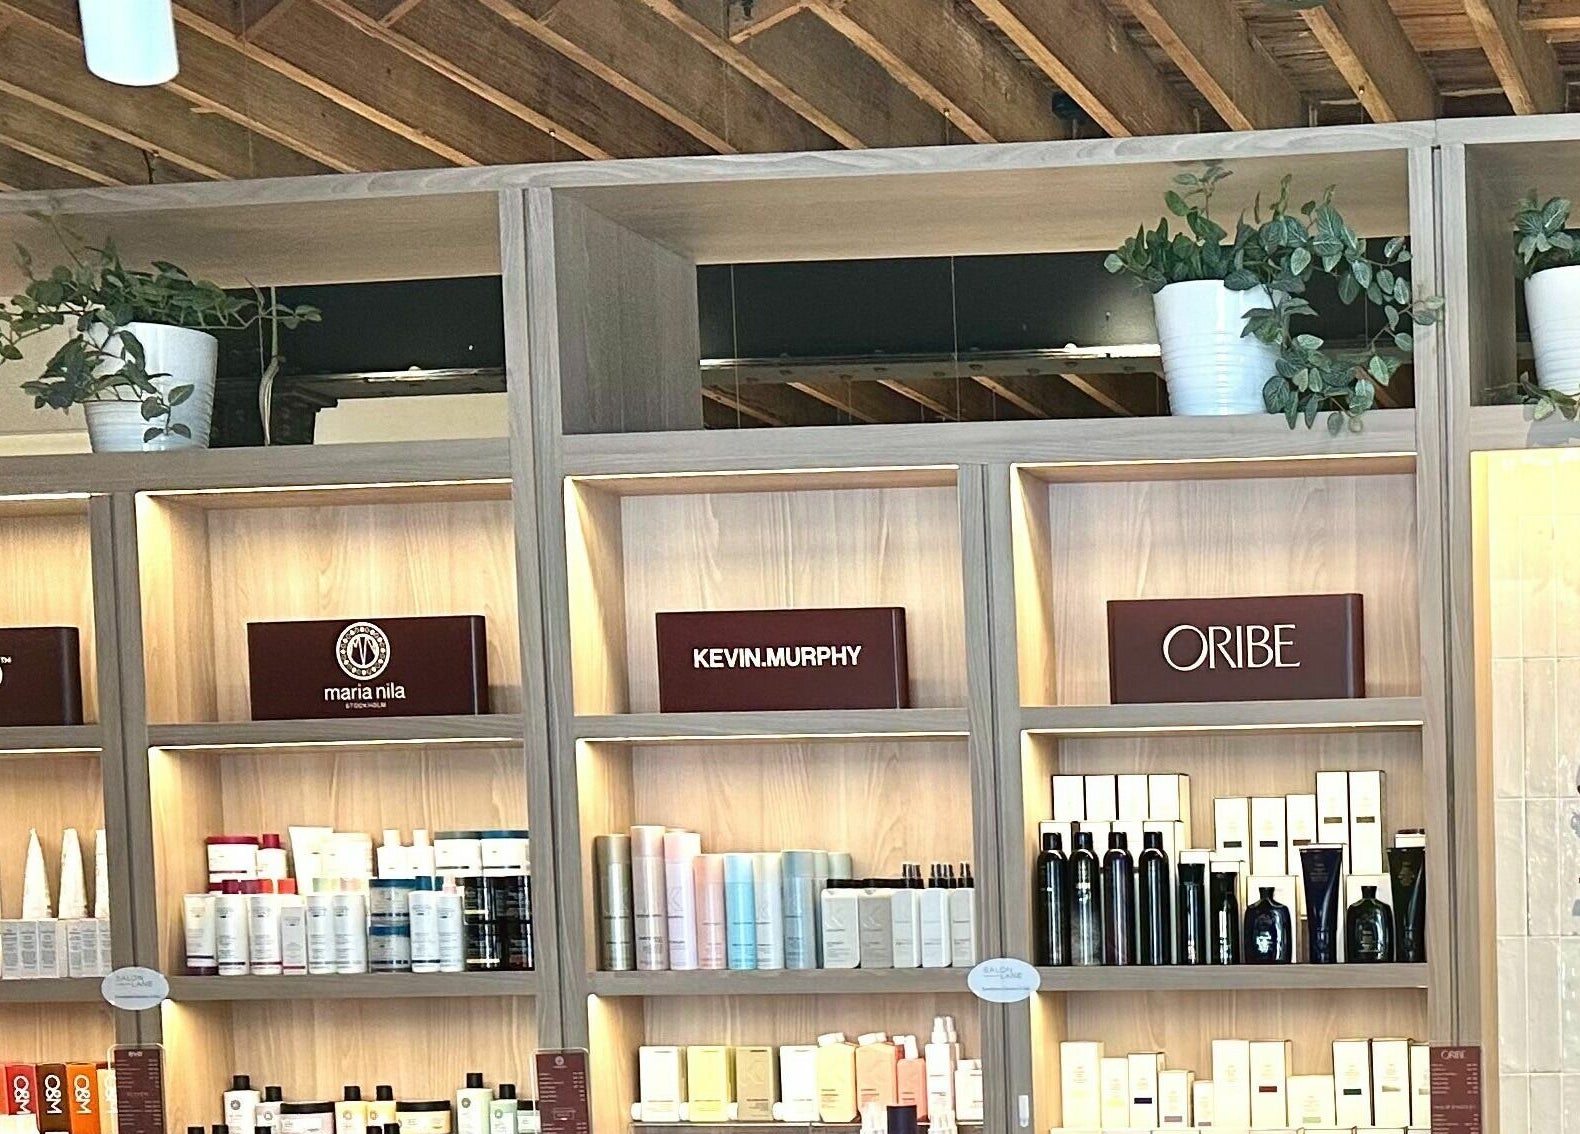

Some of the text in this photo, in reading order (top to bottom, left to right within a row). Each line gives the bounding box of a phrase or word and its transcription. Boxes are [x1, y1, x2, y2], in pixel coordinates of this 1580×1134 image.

[693, 644, 862, 669] KEVIN.MURPHY
[1161, 623, 1301, 672] ORIBE
[324, 683, 405, 701] maria nila
[13, 1075, 31, 1115] O&M
[44, 1074, 62, 1114] O&M
[73, 1074, 92, 1114] O&M
